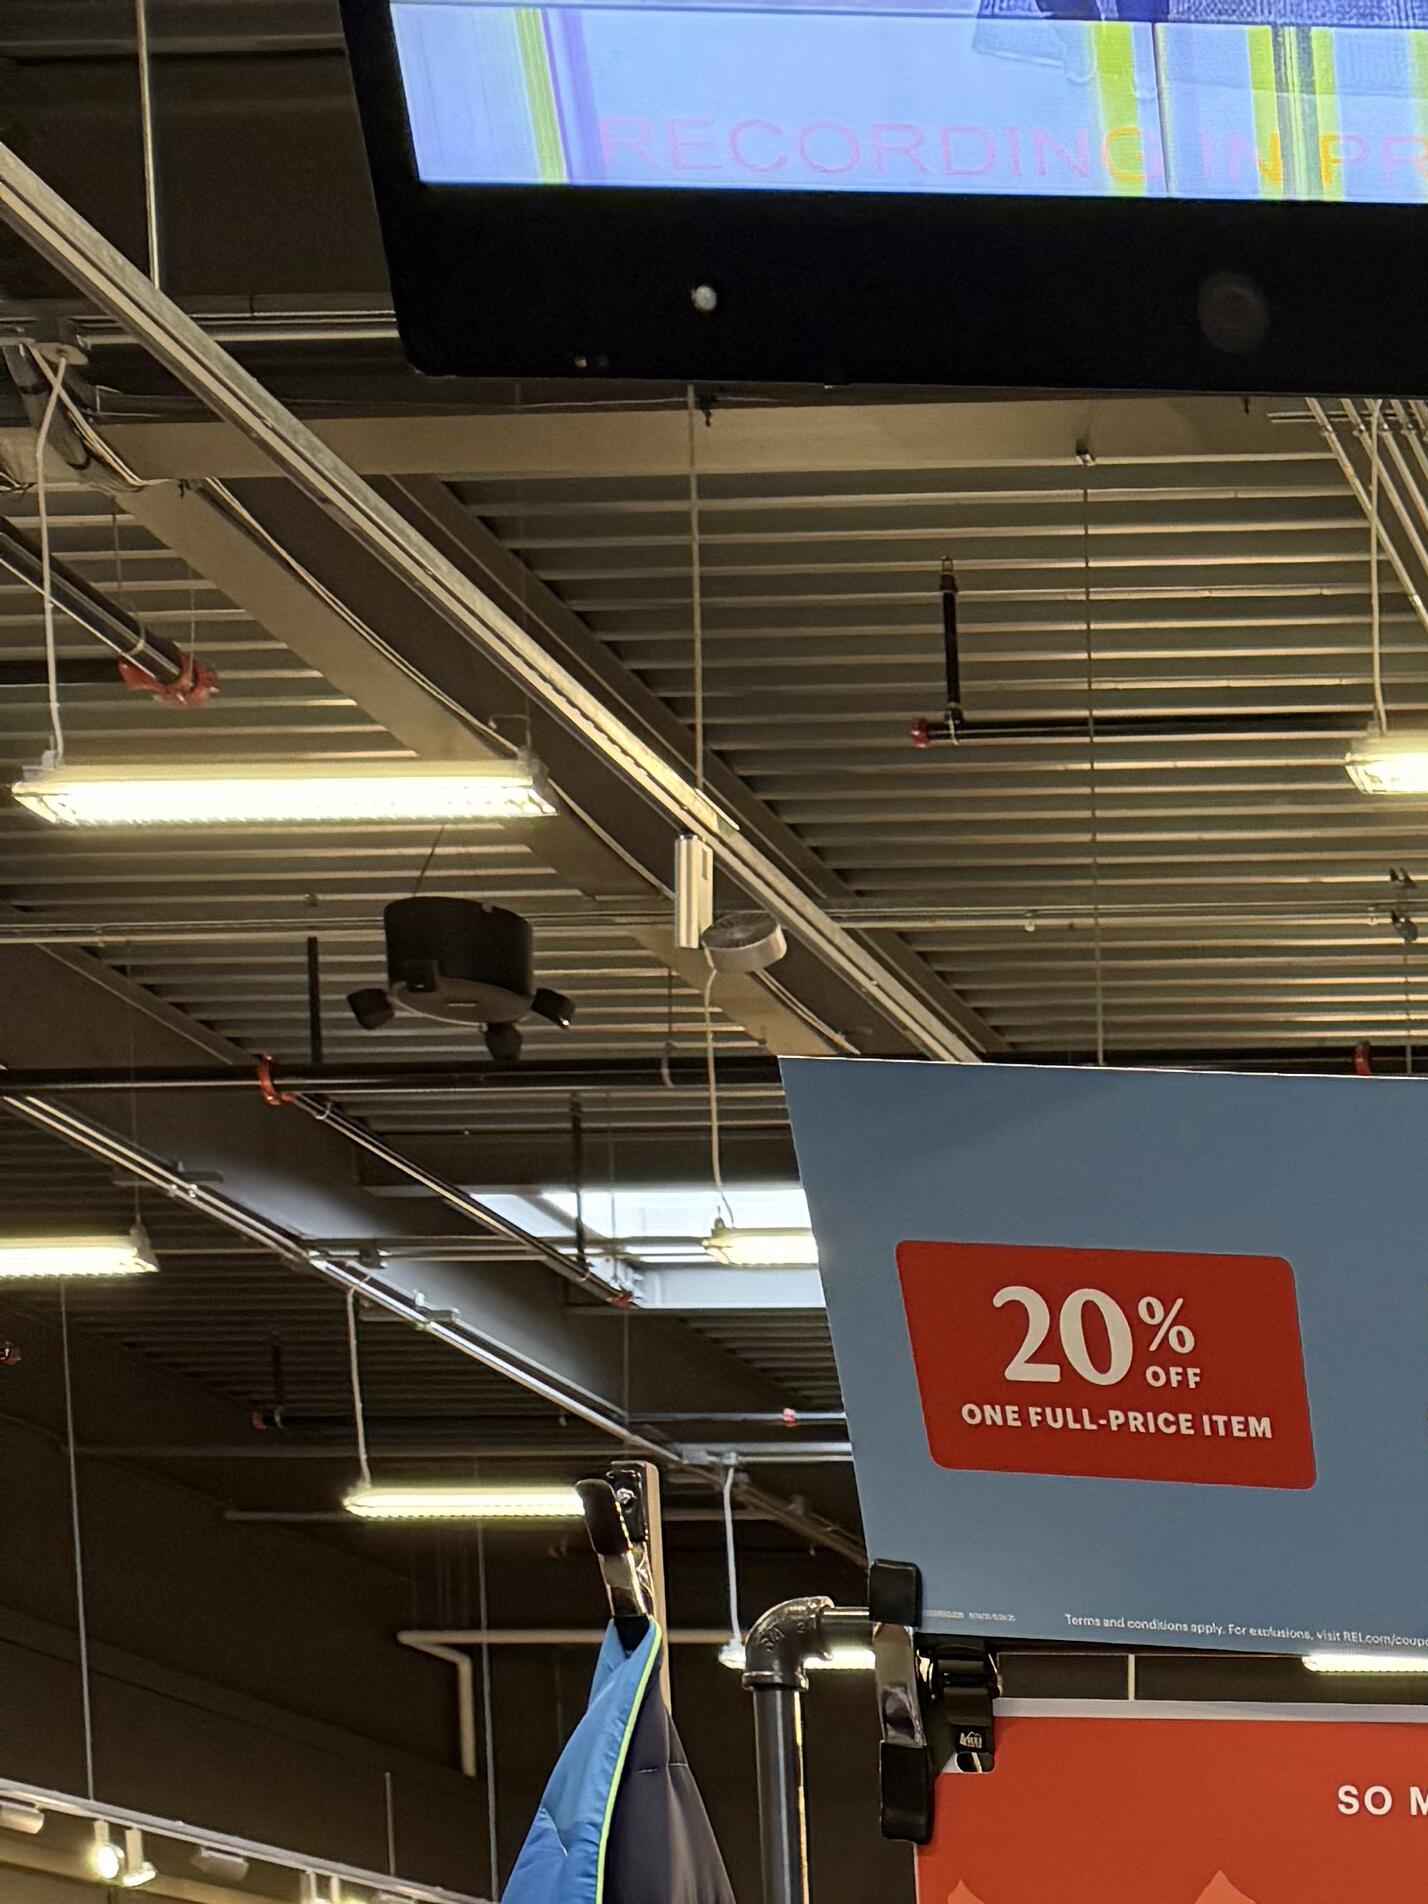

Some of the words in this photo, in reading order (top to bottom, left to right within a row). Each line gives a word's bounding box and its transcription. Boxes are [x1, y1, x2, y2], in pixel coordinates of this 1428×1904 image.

[599, 115, 1162, 184] RECORDING
[1199, 128, 1283, 185] IN
[993, 1286, 1196, 1388] 20%
[1146, 1366, 1201, 1389] OFF
[962, 1403, 1022, 1427] ONE
[1029, 1406, 1195, 1435] FULL-PRICE
[1202, 1414, 1272, 1439] ITEM
[1065, 1613, 1101, 1627] Terms
[1103, 1616, 1125, 1629] and
[1127, 1617, 1189, 1633] conditions
[1191, 1622, 1225, 1637] apply.
[1228, 1624, 1247, 1636] For
[1317, 1629, 1341, 1642] visit
[1337, 1785, 1393, 1815] SO
